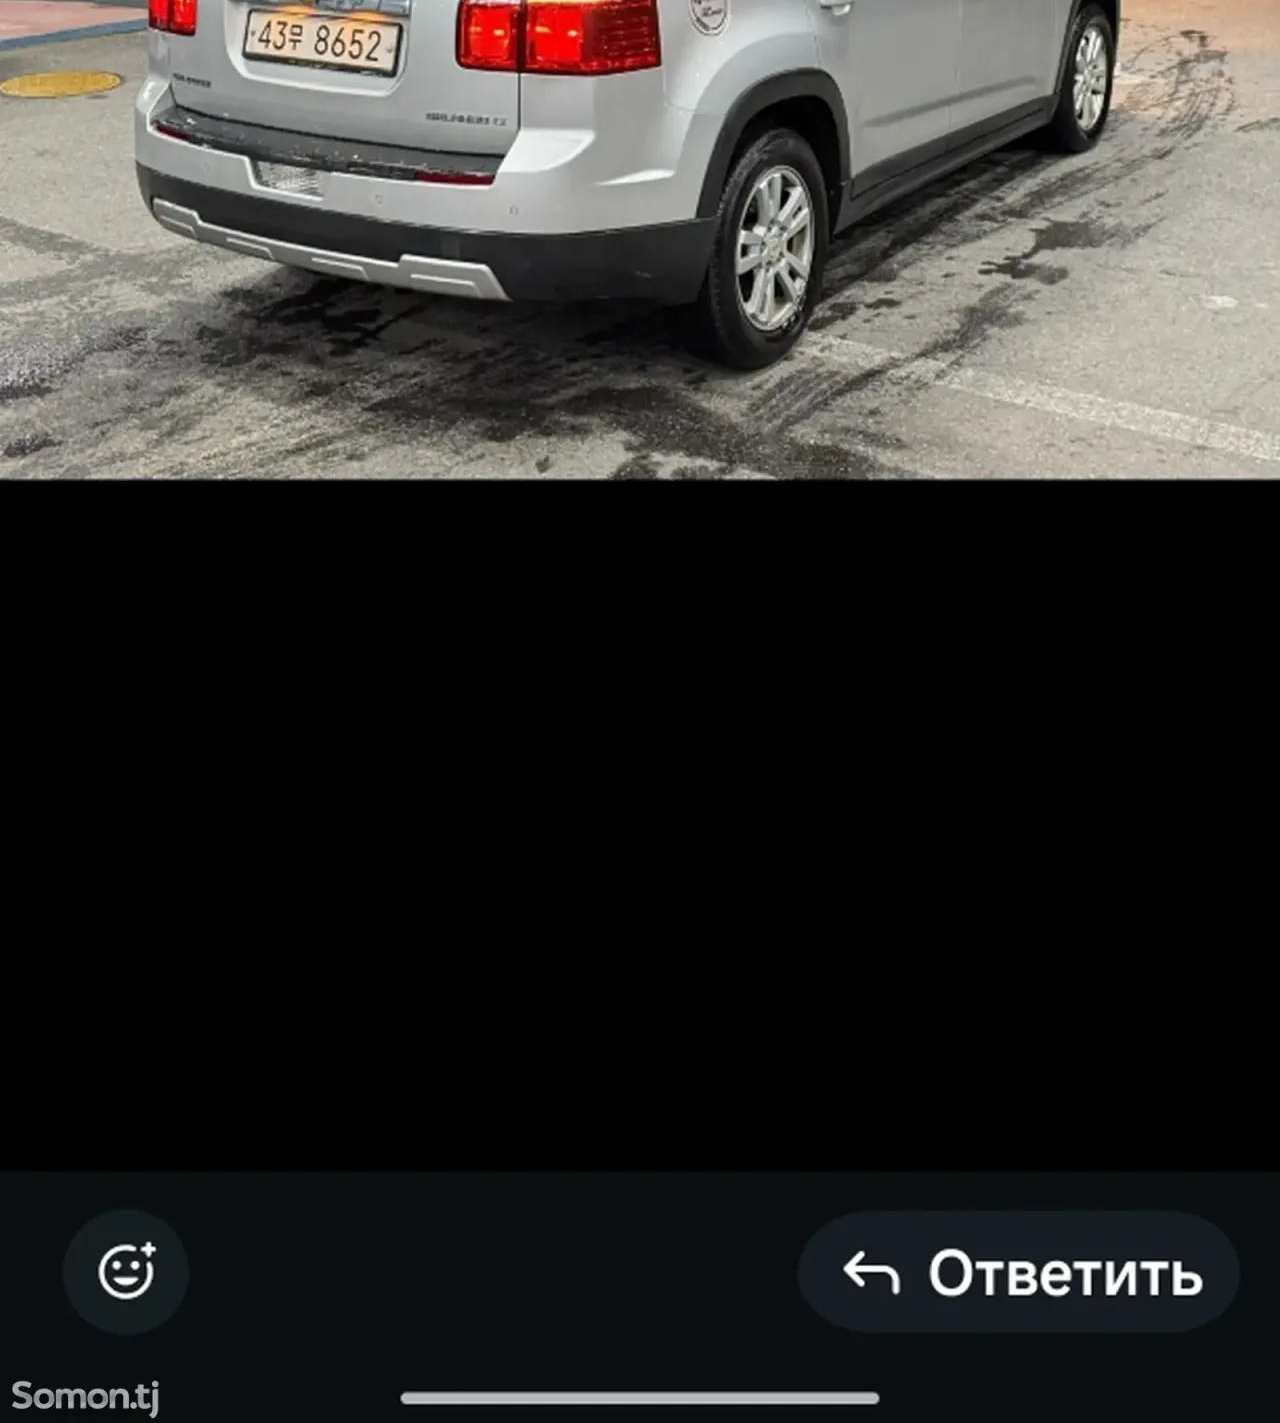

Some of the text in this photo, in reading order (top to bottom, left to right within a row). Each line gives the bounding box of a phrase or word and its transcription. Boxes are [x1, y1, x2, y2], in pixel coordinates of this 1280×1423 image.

[258, 20, 381, 62] 43무 8652
[930, 1248, 1203, 1297] Ответить
